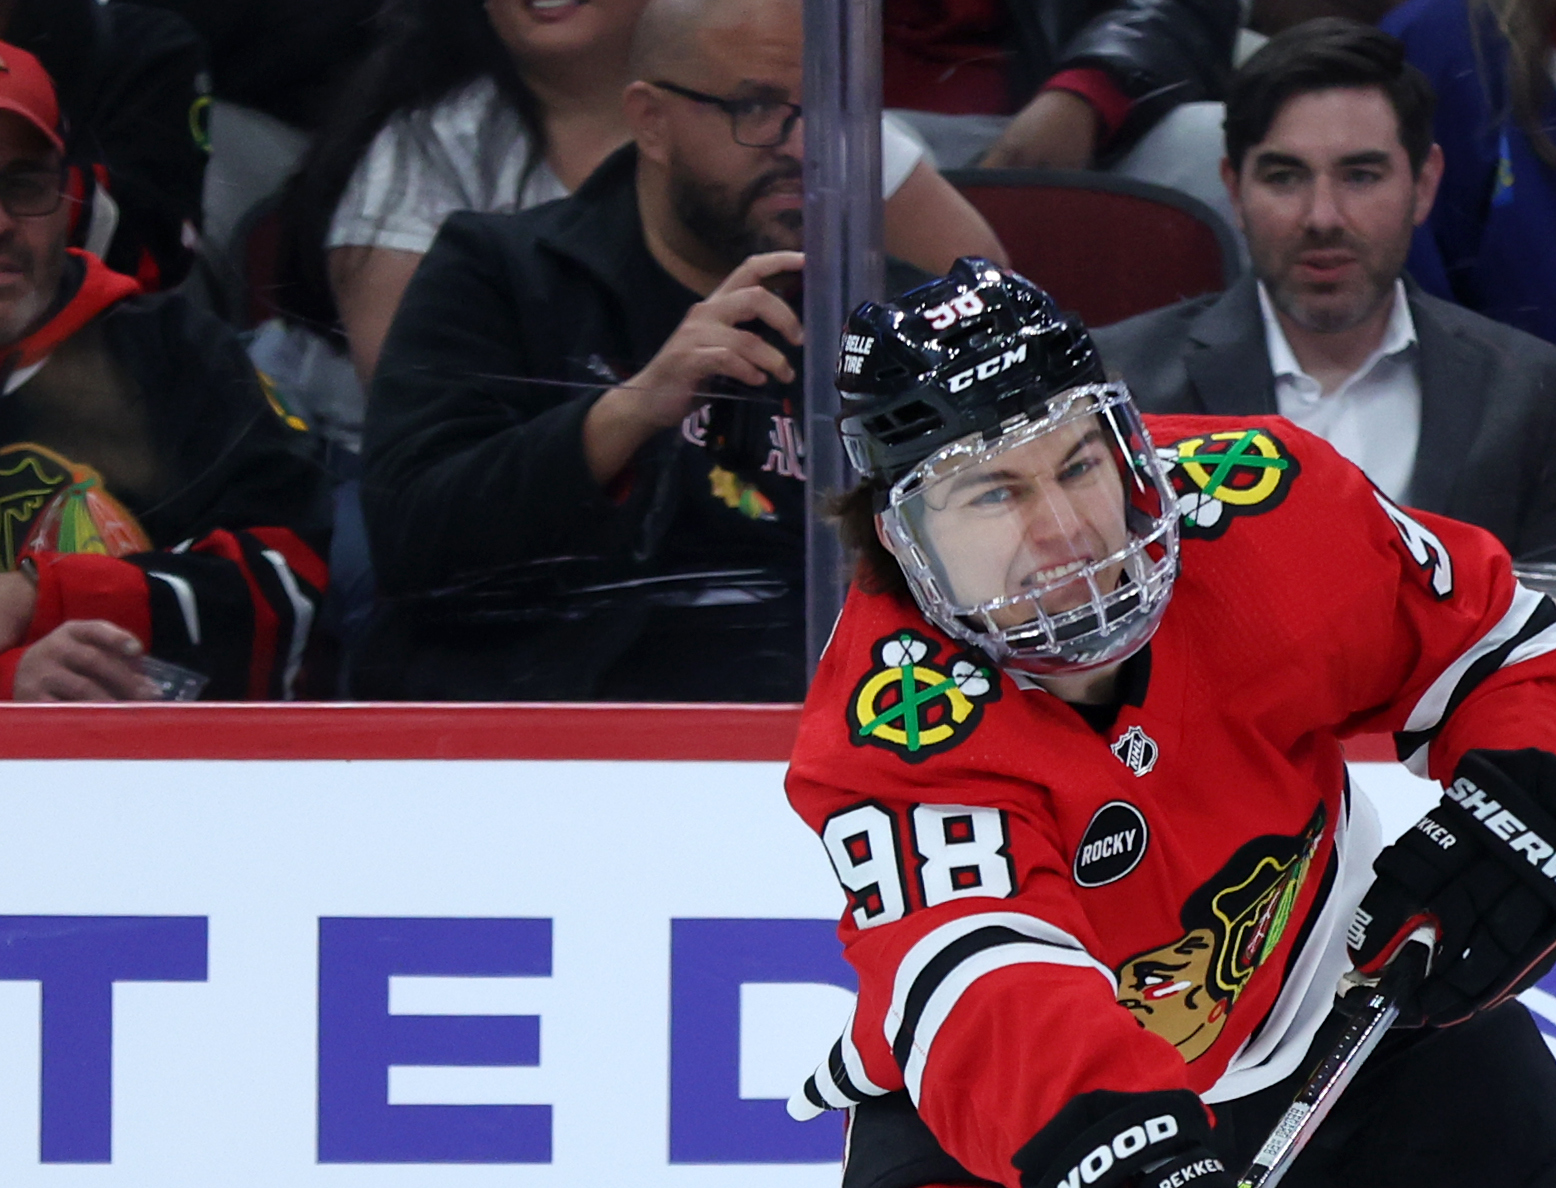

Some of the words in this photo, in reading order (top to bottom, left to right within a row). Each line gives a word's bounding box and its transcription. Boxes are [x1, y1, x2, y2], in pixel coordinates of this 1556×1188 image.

[845, 334, 875, 355] BELLE
[844, 355, 865, 375] TIRE
[947, 343, 1028, 394] CCM
[822, 800, 1018, 931] 98
[1081, 828, 1137, 867] ROCKY
